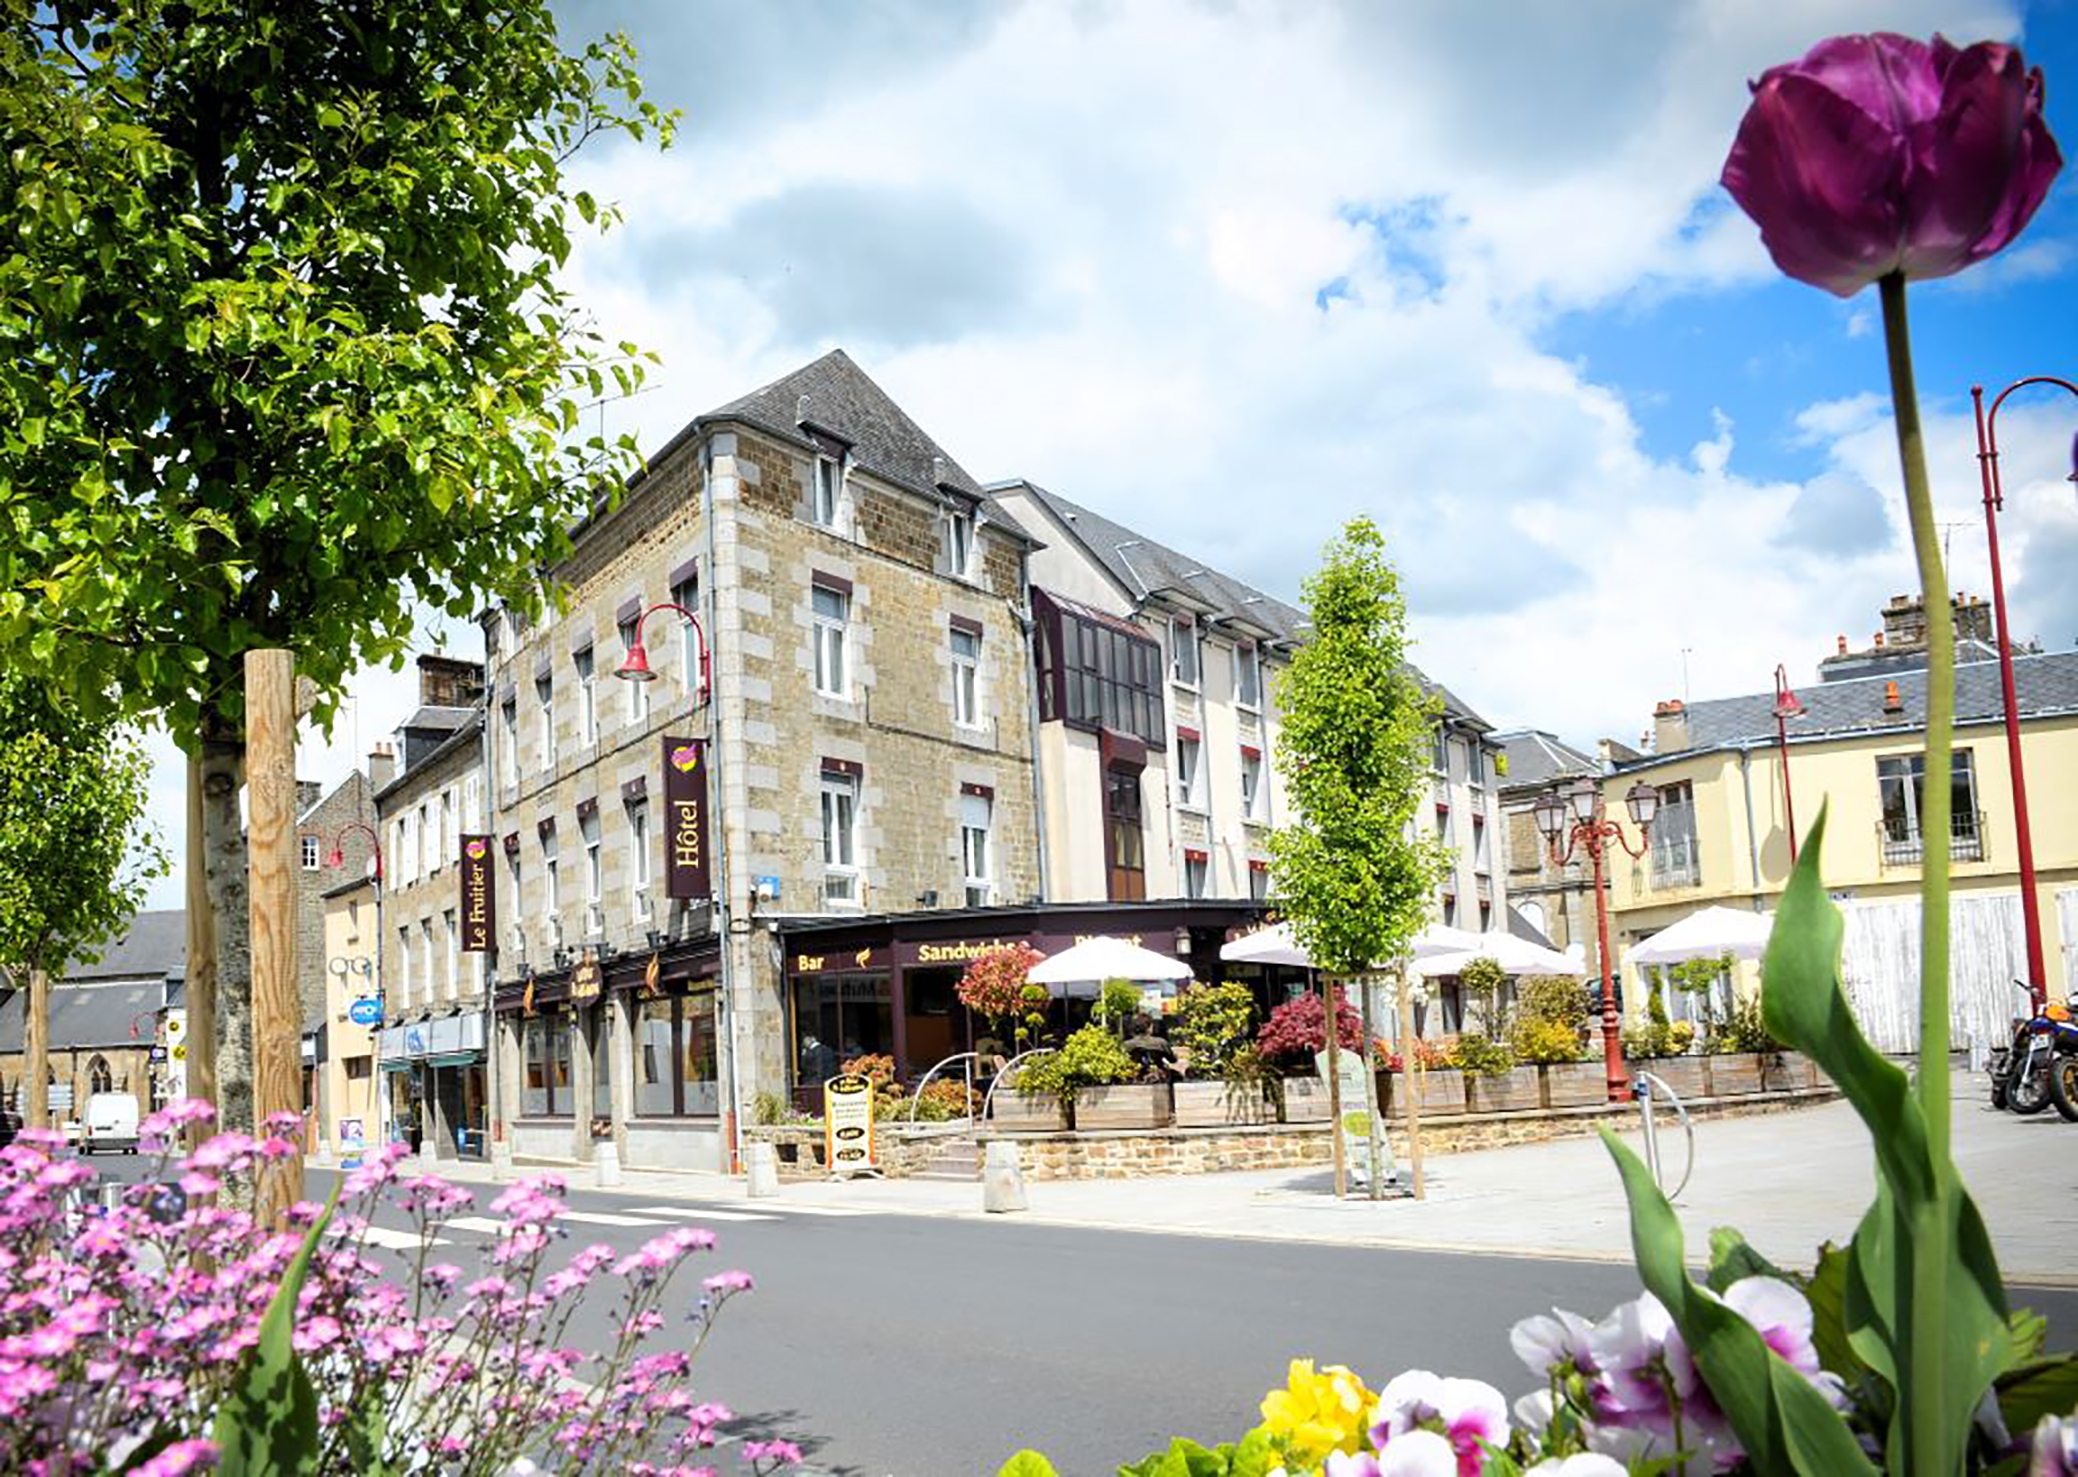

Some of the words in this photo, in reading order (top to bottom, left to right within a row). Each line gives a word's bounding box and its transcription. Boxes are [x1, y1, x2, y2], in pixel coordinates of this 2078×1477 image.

[674, 799, 699, 869] Hôtel
[468, 863, 486, 923] Fruitier
[470, 927, 486, 948] Le
[798, 955, 825, 971] Bar
